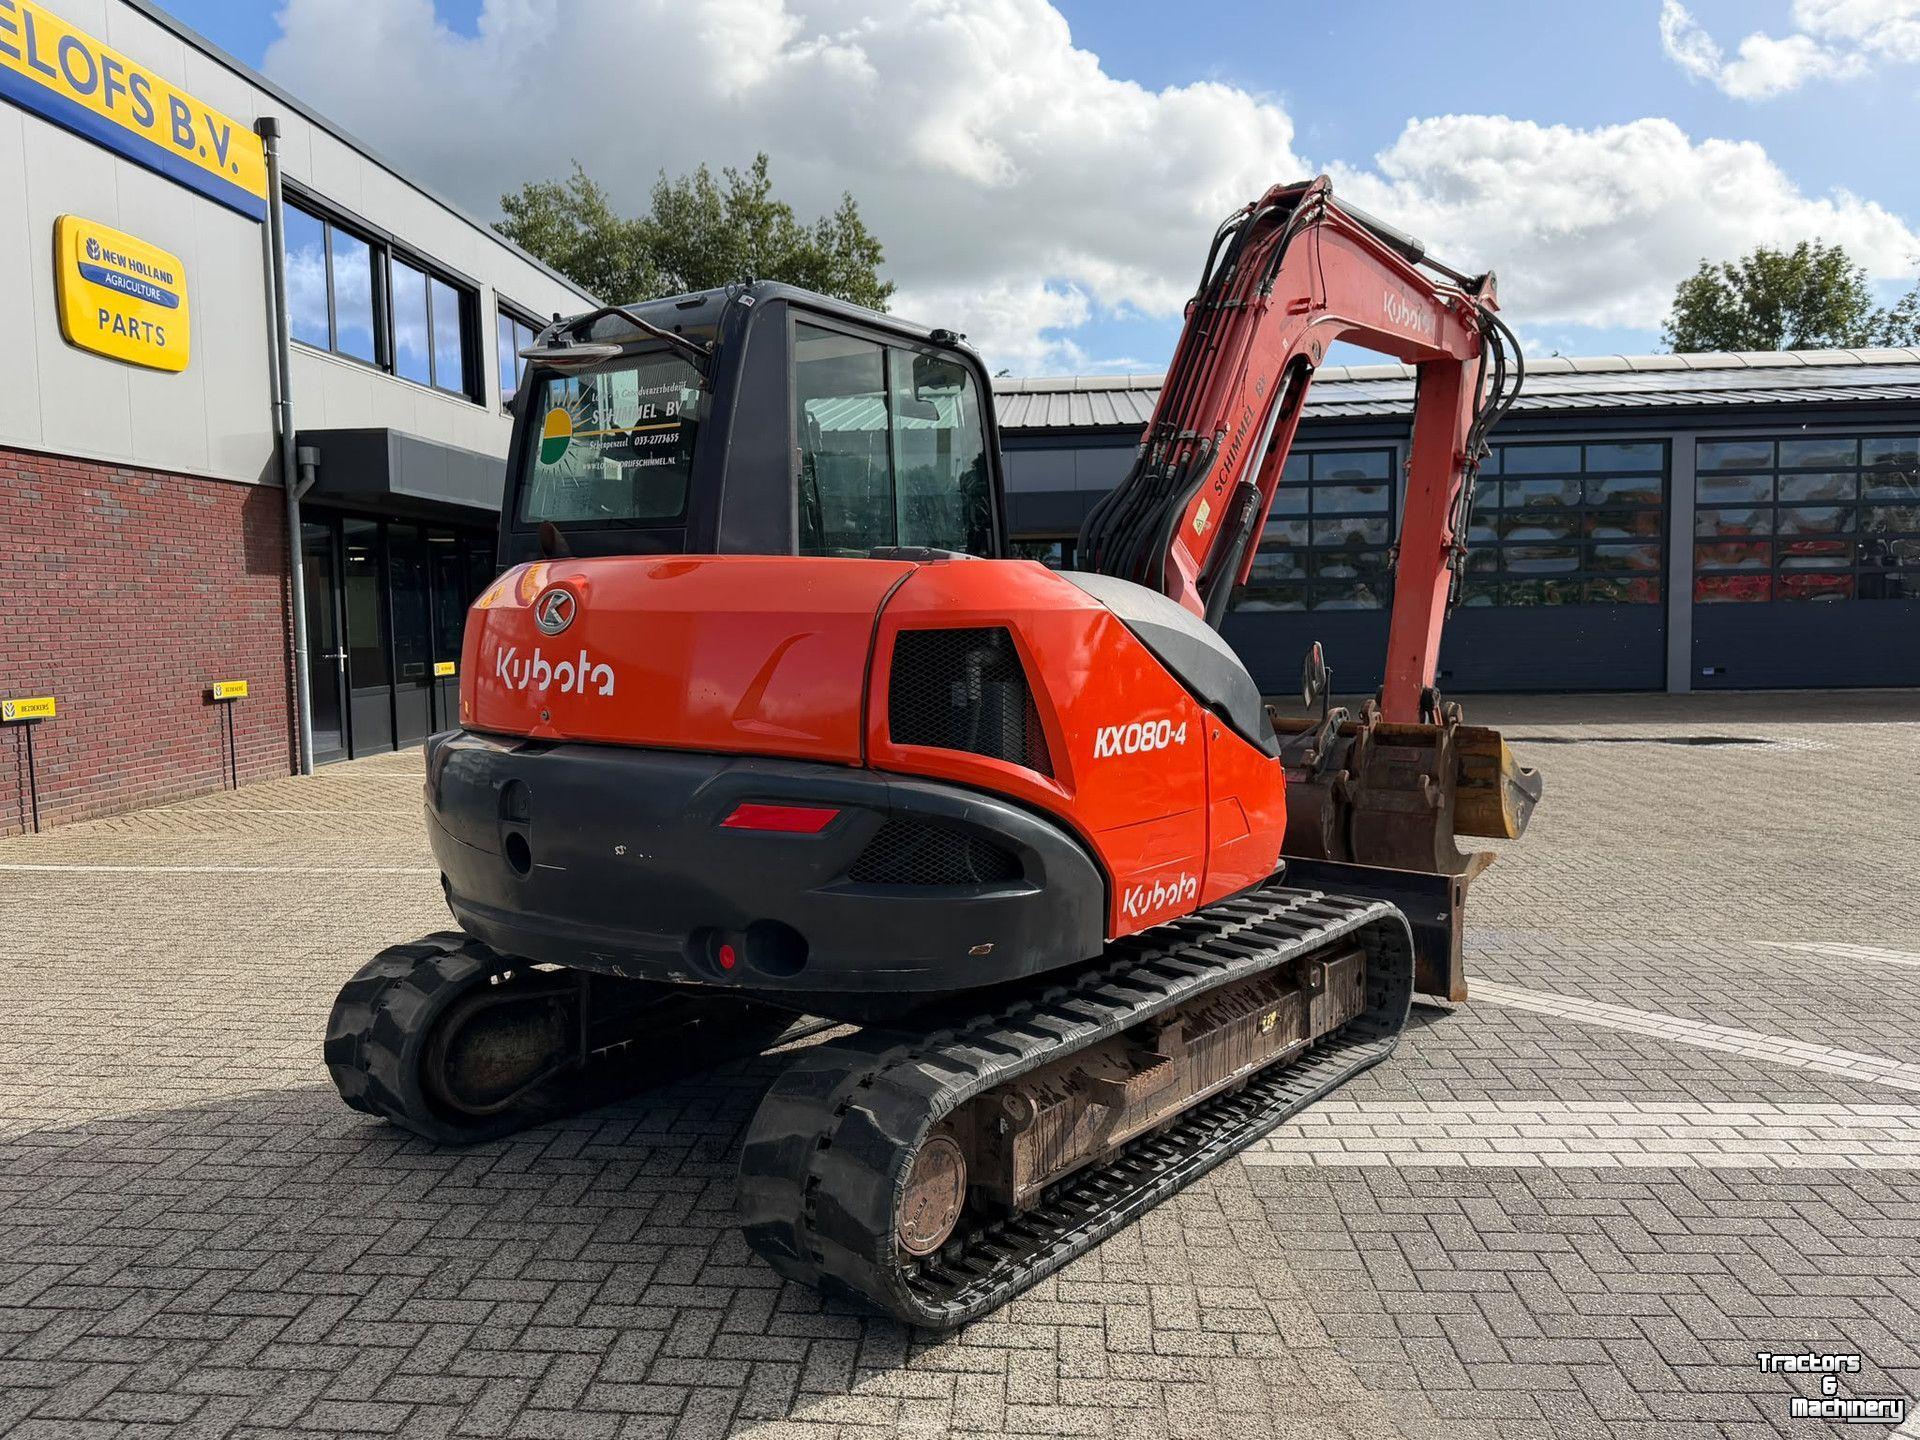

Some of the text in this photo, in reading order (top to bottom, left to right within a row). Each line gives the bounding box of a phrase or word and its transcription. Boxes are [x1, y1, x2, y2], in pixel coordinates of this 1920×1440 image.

[168, 93, 239, 175] B.V.
[102, 248, 174, 285] NEW HOLLAND
[105, 272, 162, 301] AGRICULTURE
[98, 307, 166, 347] PARTS
[665, 400, 683, 417] BV
[1214, 404, 1257, 497] SCHIMMEL
[496, 646, 615, 697] Kubota
[1093, 719, 1187, 759] KX080-4
[1122, 871, 1197, 918] Kubota
